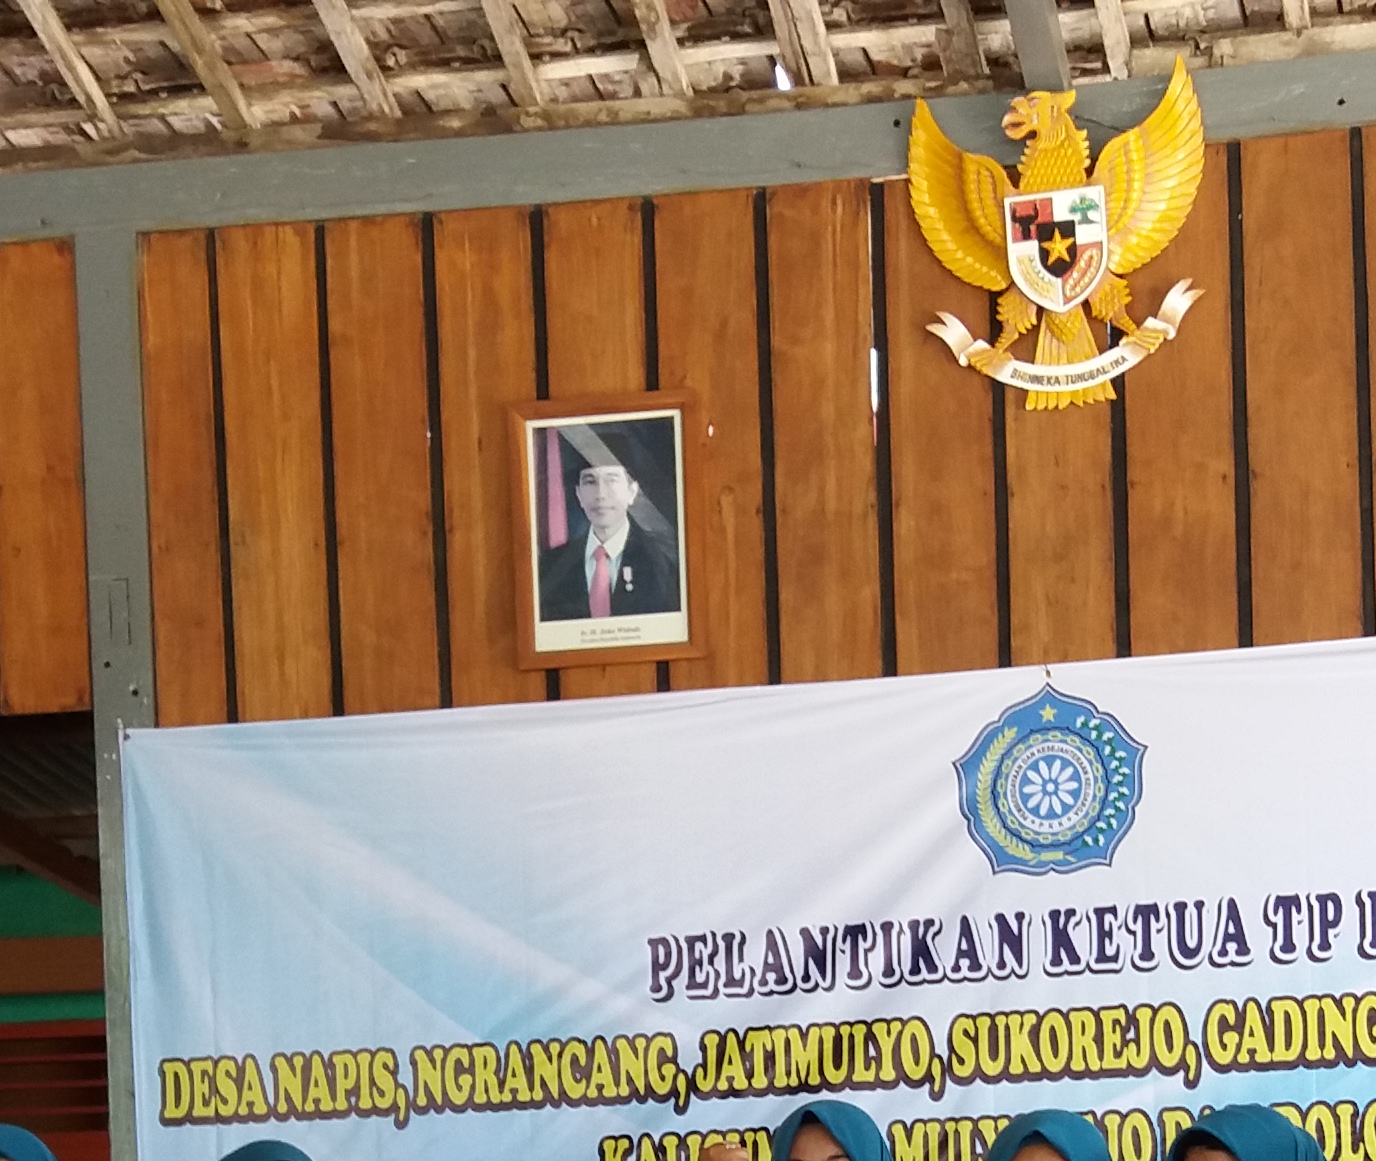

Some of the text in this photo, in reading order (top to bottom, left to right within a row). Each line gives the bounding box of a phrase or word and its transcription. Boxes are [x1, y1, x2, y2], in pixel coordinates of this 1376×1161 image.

[1010, 367, 1062, 387] BHINNEKA
[1064, 365, 1110, 386] TUNGGAL
[646, 910, 1032, 1003] PELANTIKAN
[1042, 896, 1254, 977] KETUA
[1263, 891, 1343, 965] TP
[160, 1052, 272, 1128] DESA
[272, 1045, 409, 1129] NAPIS,
[410, 1031, 689, 1116] NGRANCANG,
[693, 1015, 947, 1102] JATIMULYO,
[947, 1000, 1202, 1090] SUKOREJO,
